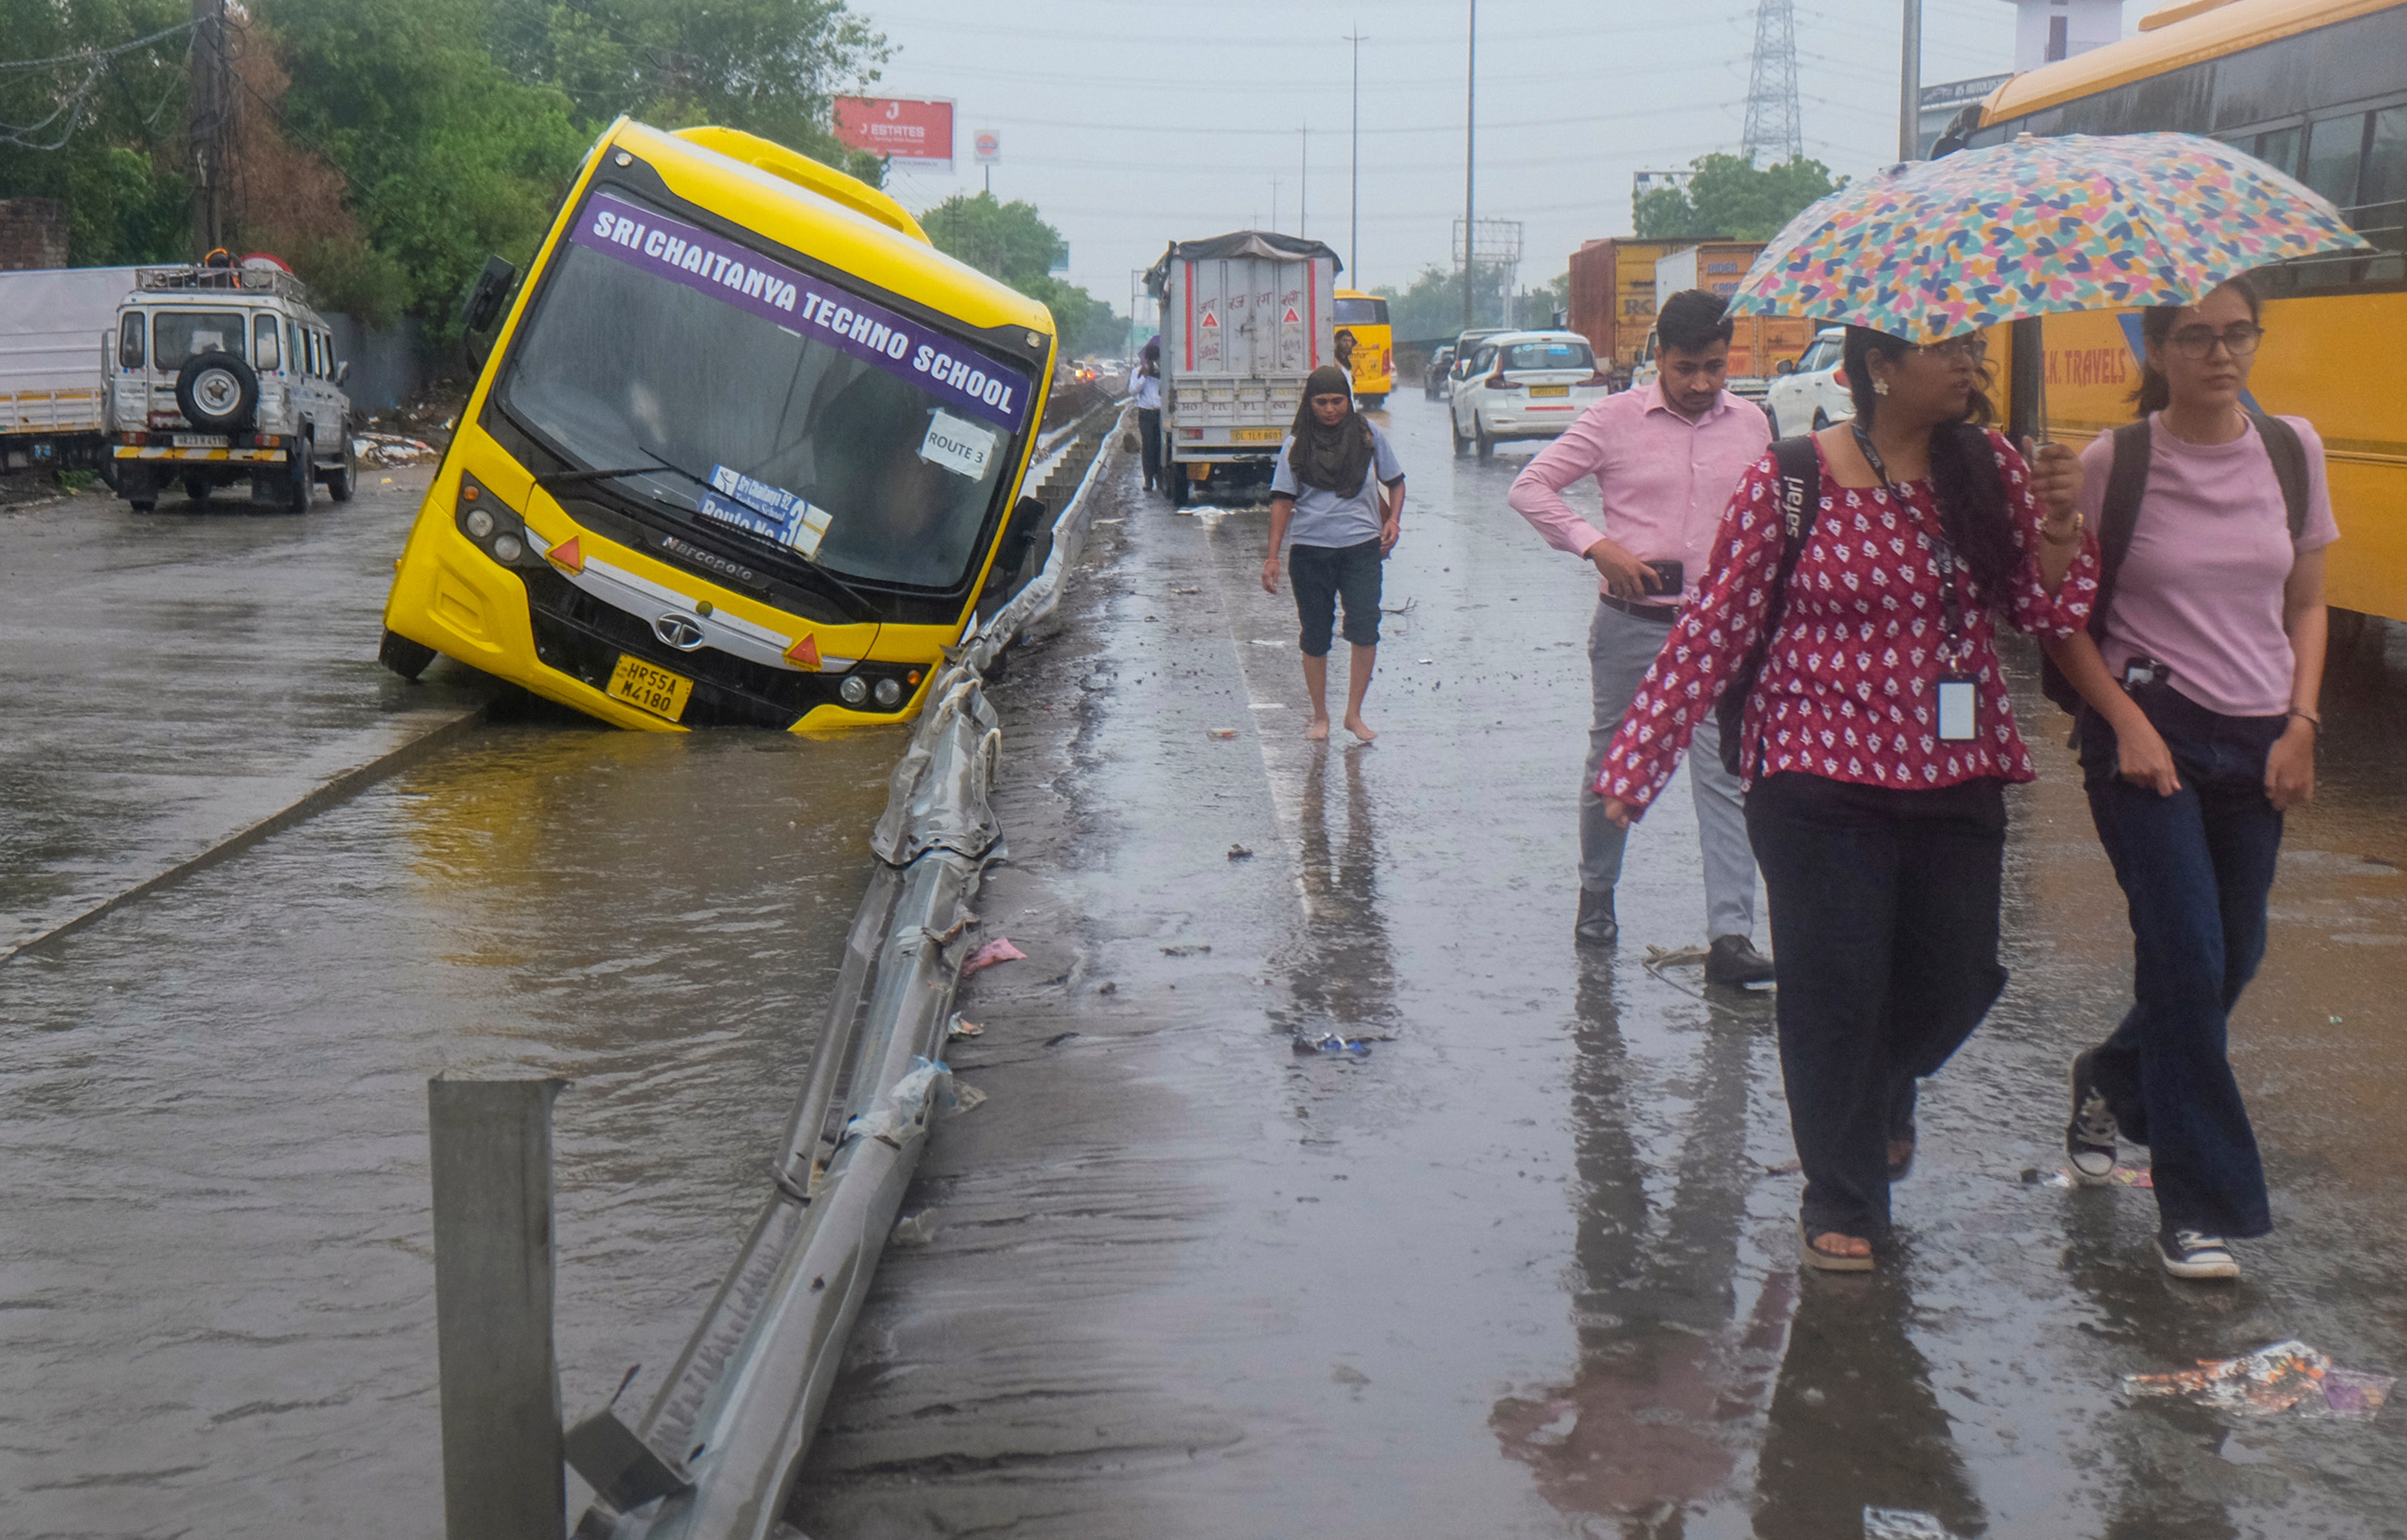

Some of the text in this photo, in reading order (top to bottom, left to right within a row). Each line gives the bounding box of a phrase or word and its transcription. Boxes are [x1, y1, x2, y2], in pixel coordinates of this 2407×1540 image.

[871, 124, 925, 137] ESTATES
[593, 211, 1013, 415] SRI CHAITANYA TECHNO SCHOOL
[2065, 347, 2126, 388] TRAVELS
[928, 432, 984, 463] ROUTE 3
[737, 476, 749, 493] Sri
[761, 502, 786, 521] School
[1782, 475, 1804, 539] safari
[662, 535, 752, 581] Marcopolo
[626, 662, 677, 696] HR55A
[620, 680, 671, 712] M4180
